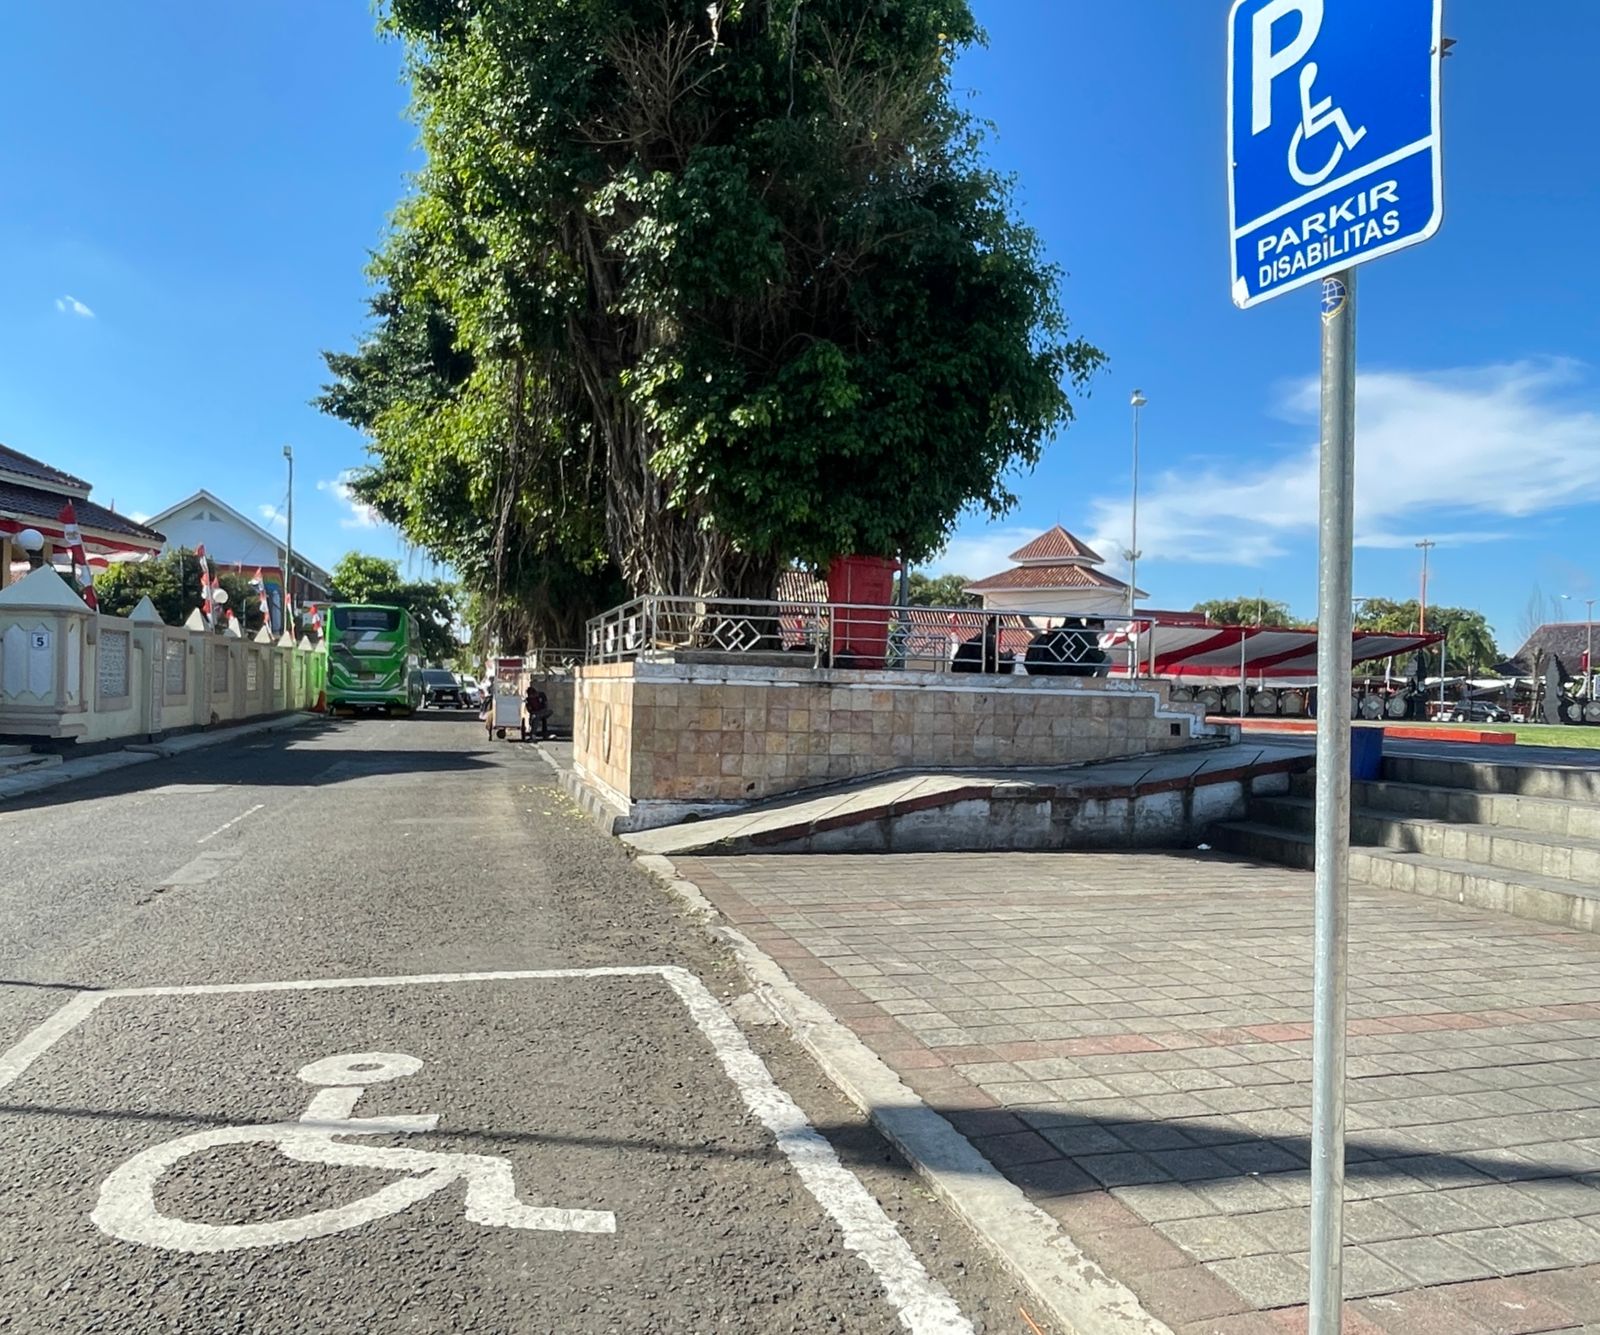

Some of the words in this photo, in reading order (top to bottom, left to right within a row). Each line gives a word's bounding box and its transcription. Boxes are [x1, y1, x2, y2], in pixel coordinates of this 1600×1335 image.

[1251, 0, 1325, 136] P
[1257, 179, 1400, 262] PARKIR
[1258, 210, 1401, 288] DISABILITAS
[36, 636, 45, 647] 5
